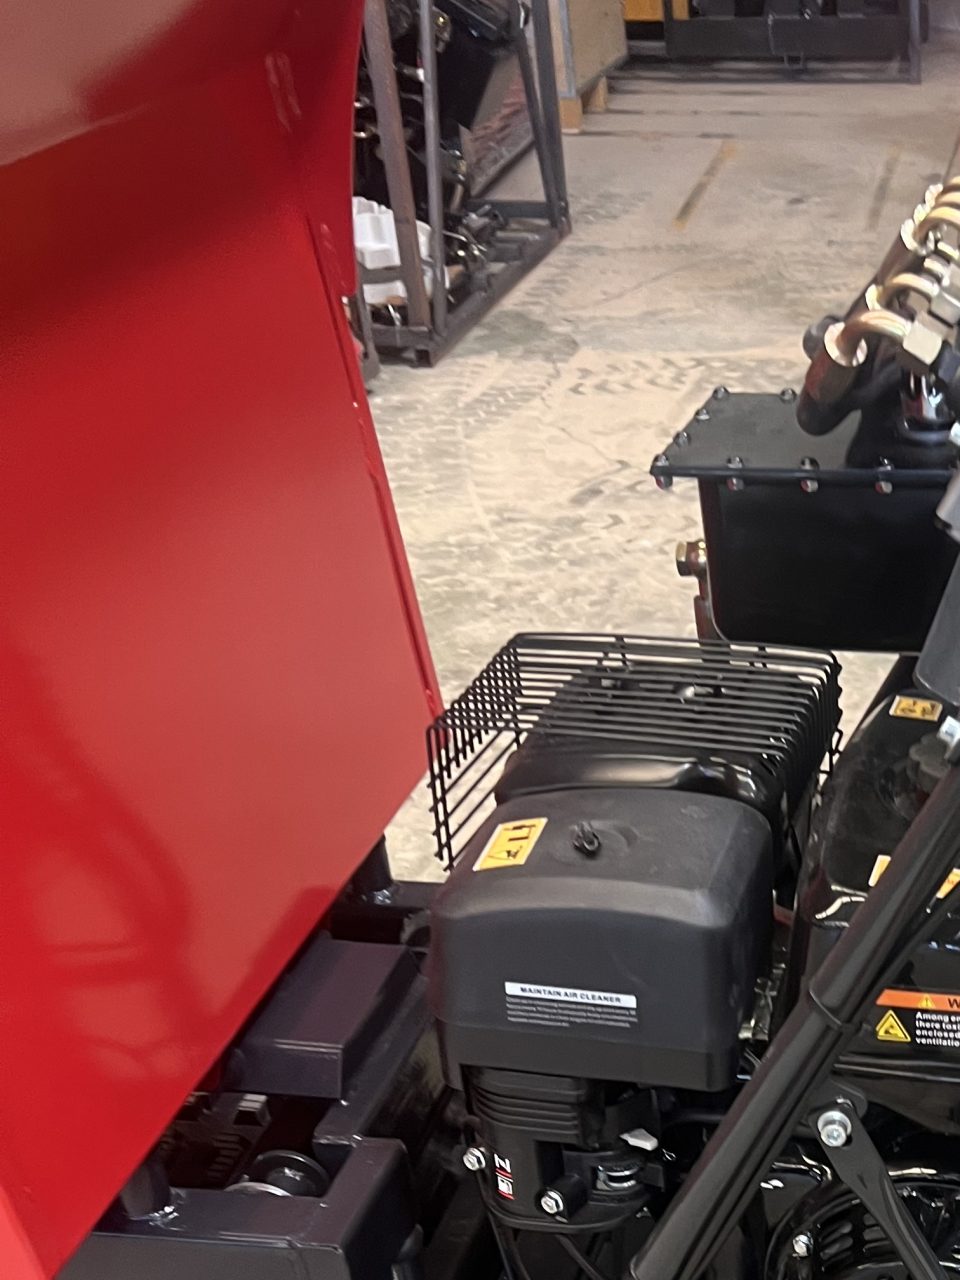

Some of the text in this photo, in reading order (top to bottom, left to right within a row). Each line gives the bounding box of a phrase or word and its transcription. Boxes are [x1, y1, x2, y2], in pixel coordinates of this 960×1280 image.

[520, 986, 622, 1004] MAINTAIN AIR CLEANER
[915, 1011, 950, 1023] Among
[915, 1020, 940, 1030] there
[915, 1029, 960, 1039] enclosed
